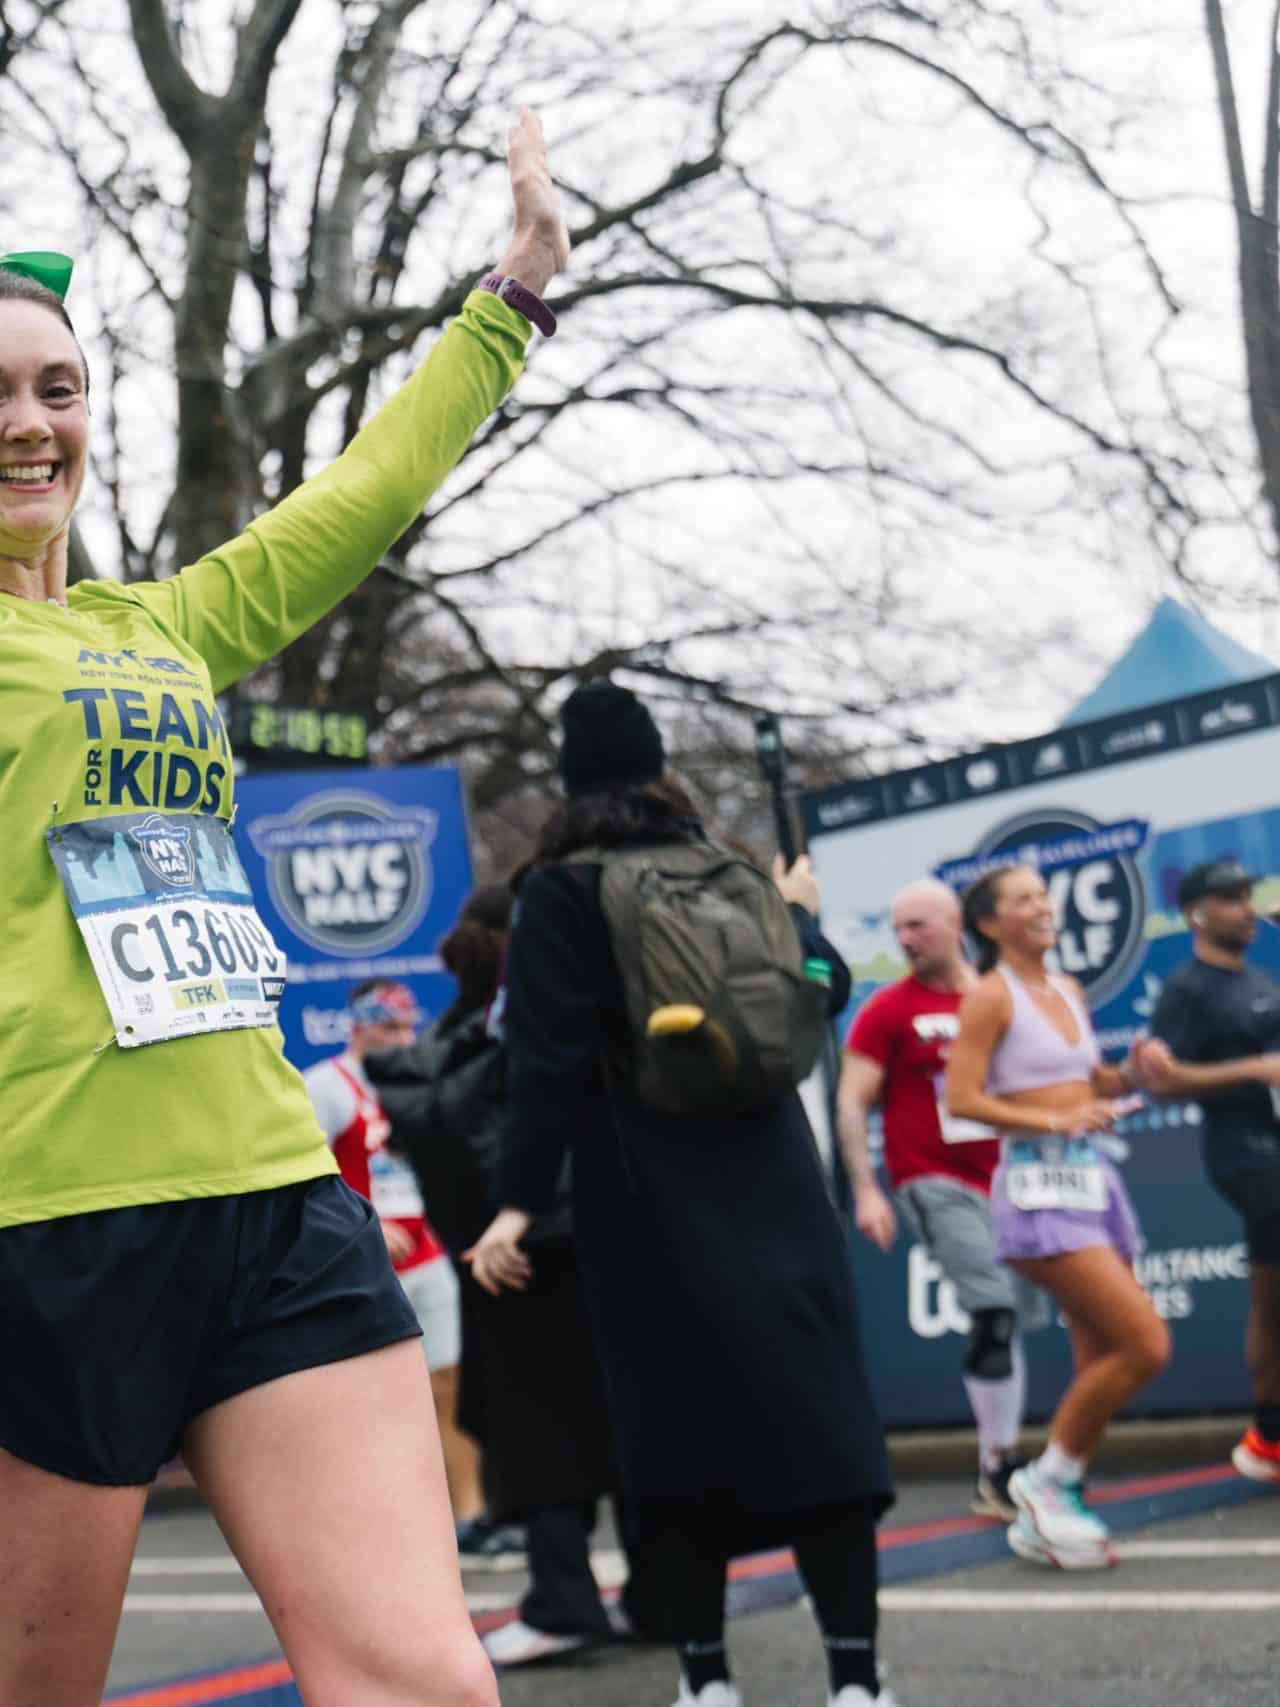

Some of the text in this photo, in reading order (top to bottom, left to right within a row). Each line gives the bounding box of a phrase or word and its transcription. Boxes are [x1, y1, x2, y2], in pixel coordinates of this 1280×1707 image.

[63, 688, 228, 759] TEAM
[84, 748, 102, 806] FOR
[108, 748, 226, 815] KIDS
[291, 842, 408, 896] NYC
[304, 890, 402, 926] HALF
[182, 984, 217, 1005] TFK
